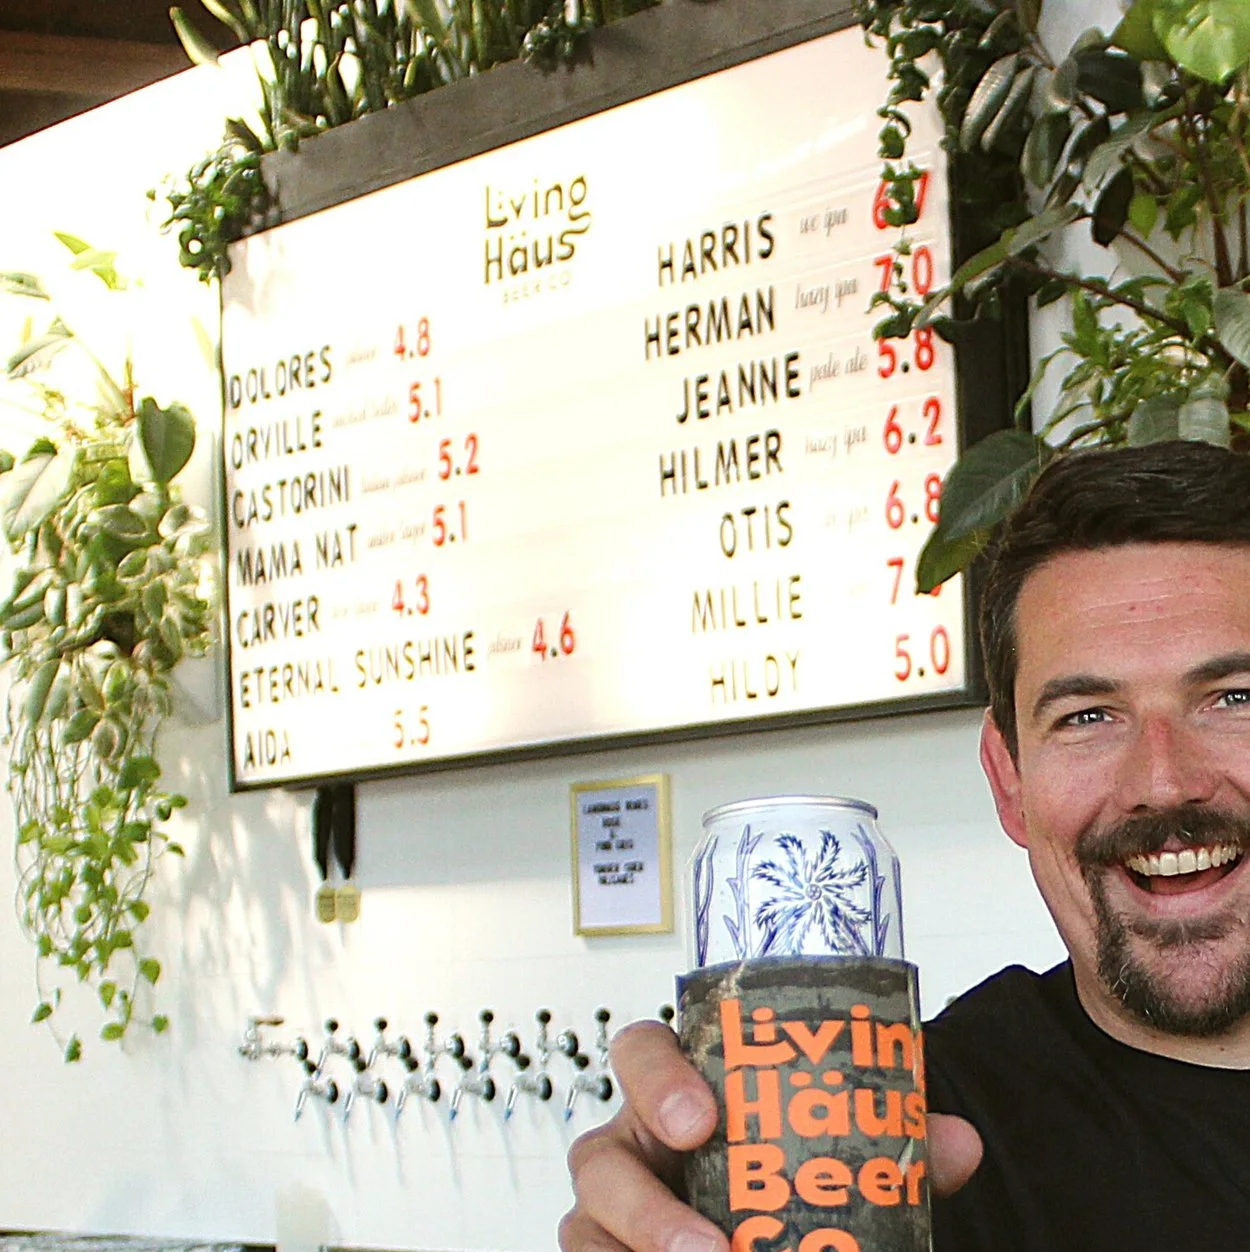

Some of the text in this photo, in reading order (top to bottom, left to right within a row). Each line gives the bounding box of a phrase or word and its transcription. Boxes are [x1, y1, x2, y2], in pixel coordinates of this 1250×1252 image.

[485, 175, 591, 229] Living
[658, 213, 774, 287] HARRIS
[872, 170, 929, 229] 67
[484, 224, 590, 285] Häus
[229, 345, 333, 409] DOLORES
[393, 316, 431, 360] 4.8
[645, 285, 775, 360] HERMAN
[676, 351, 801, 423] JEANNE
[878, 327, 934, 378] 5.8
[230, 410, 323, 470] ORVILLE
[408, 376, 443, 423] 5.1
[659, 429, 783, 497] HILMER
[882, 396, 943, 454] 6.2
[231, 465, 351, 529] CASTORINI
[437, 433, 480, 481] 5.2
[719, 500, 793, 559] OTIS
[885, 472, 942, 529] 6.8
[236, 540, 303, 586] MAMA
[315, 524, 359, 570] NAT
[431, 501, 469, 547] 5.1
[236, 573, 430, 650] CARVER 4.3
[691, 574, 803, 634] MILLIE
[239, 656, 340, 709] ETERNAL
[355, 630, 476, 688] SUNSHINE
[532, 609, 575, 661] 4.6
[710, 625, 950, 704] HILDY 5.0
[243, 705, 430, 771] AIDA 5.5
[720, 998, 925, 1092] Livin
[725, 1069, 927, 1142] Häus
[728, 1143, 925, 1212] Beer
